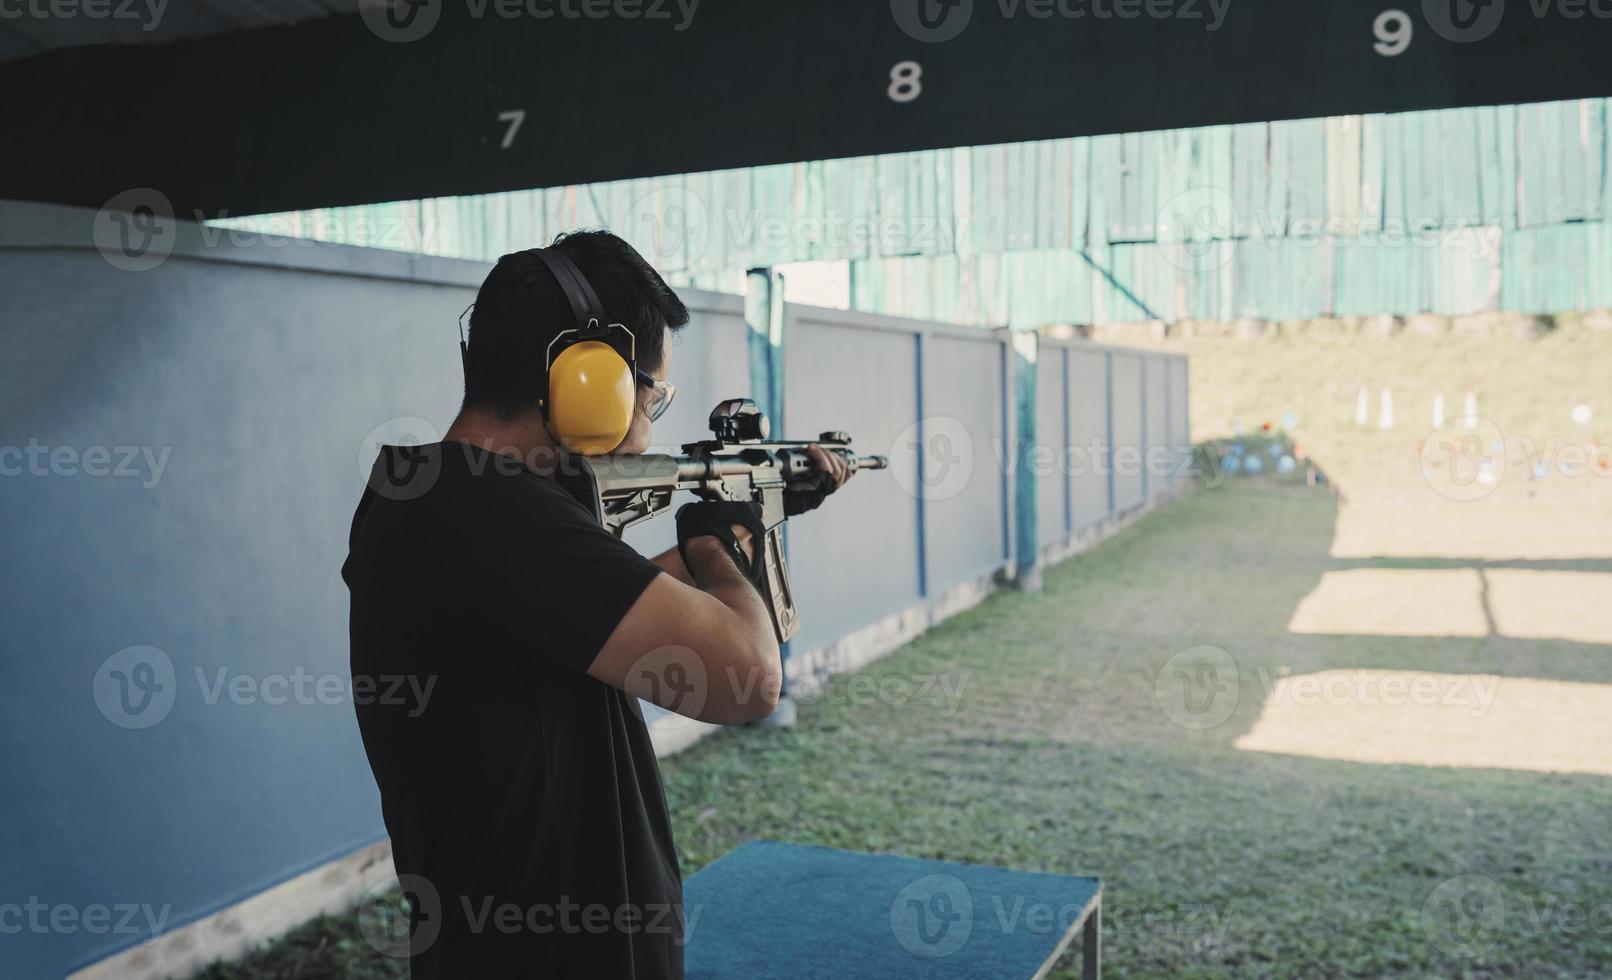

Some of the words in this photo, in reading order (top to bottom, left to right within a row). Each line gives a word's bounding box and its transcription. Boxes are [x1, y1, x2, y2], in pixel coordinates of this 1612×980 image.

[1373, 9, 1413, 57] 9
[887, 60, 923, 103] 8
[498, 110, 526, 149] 7
